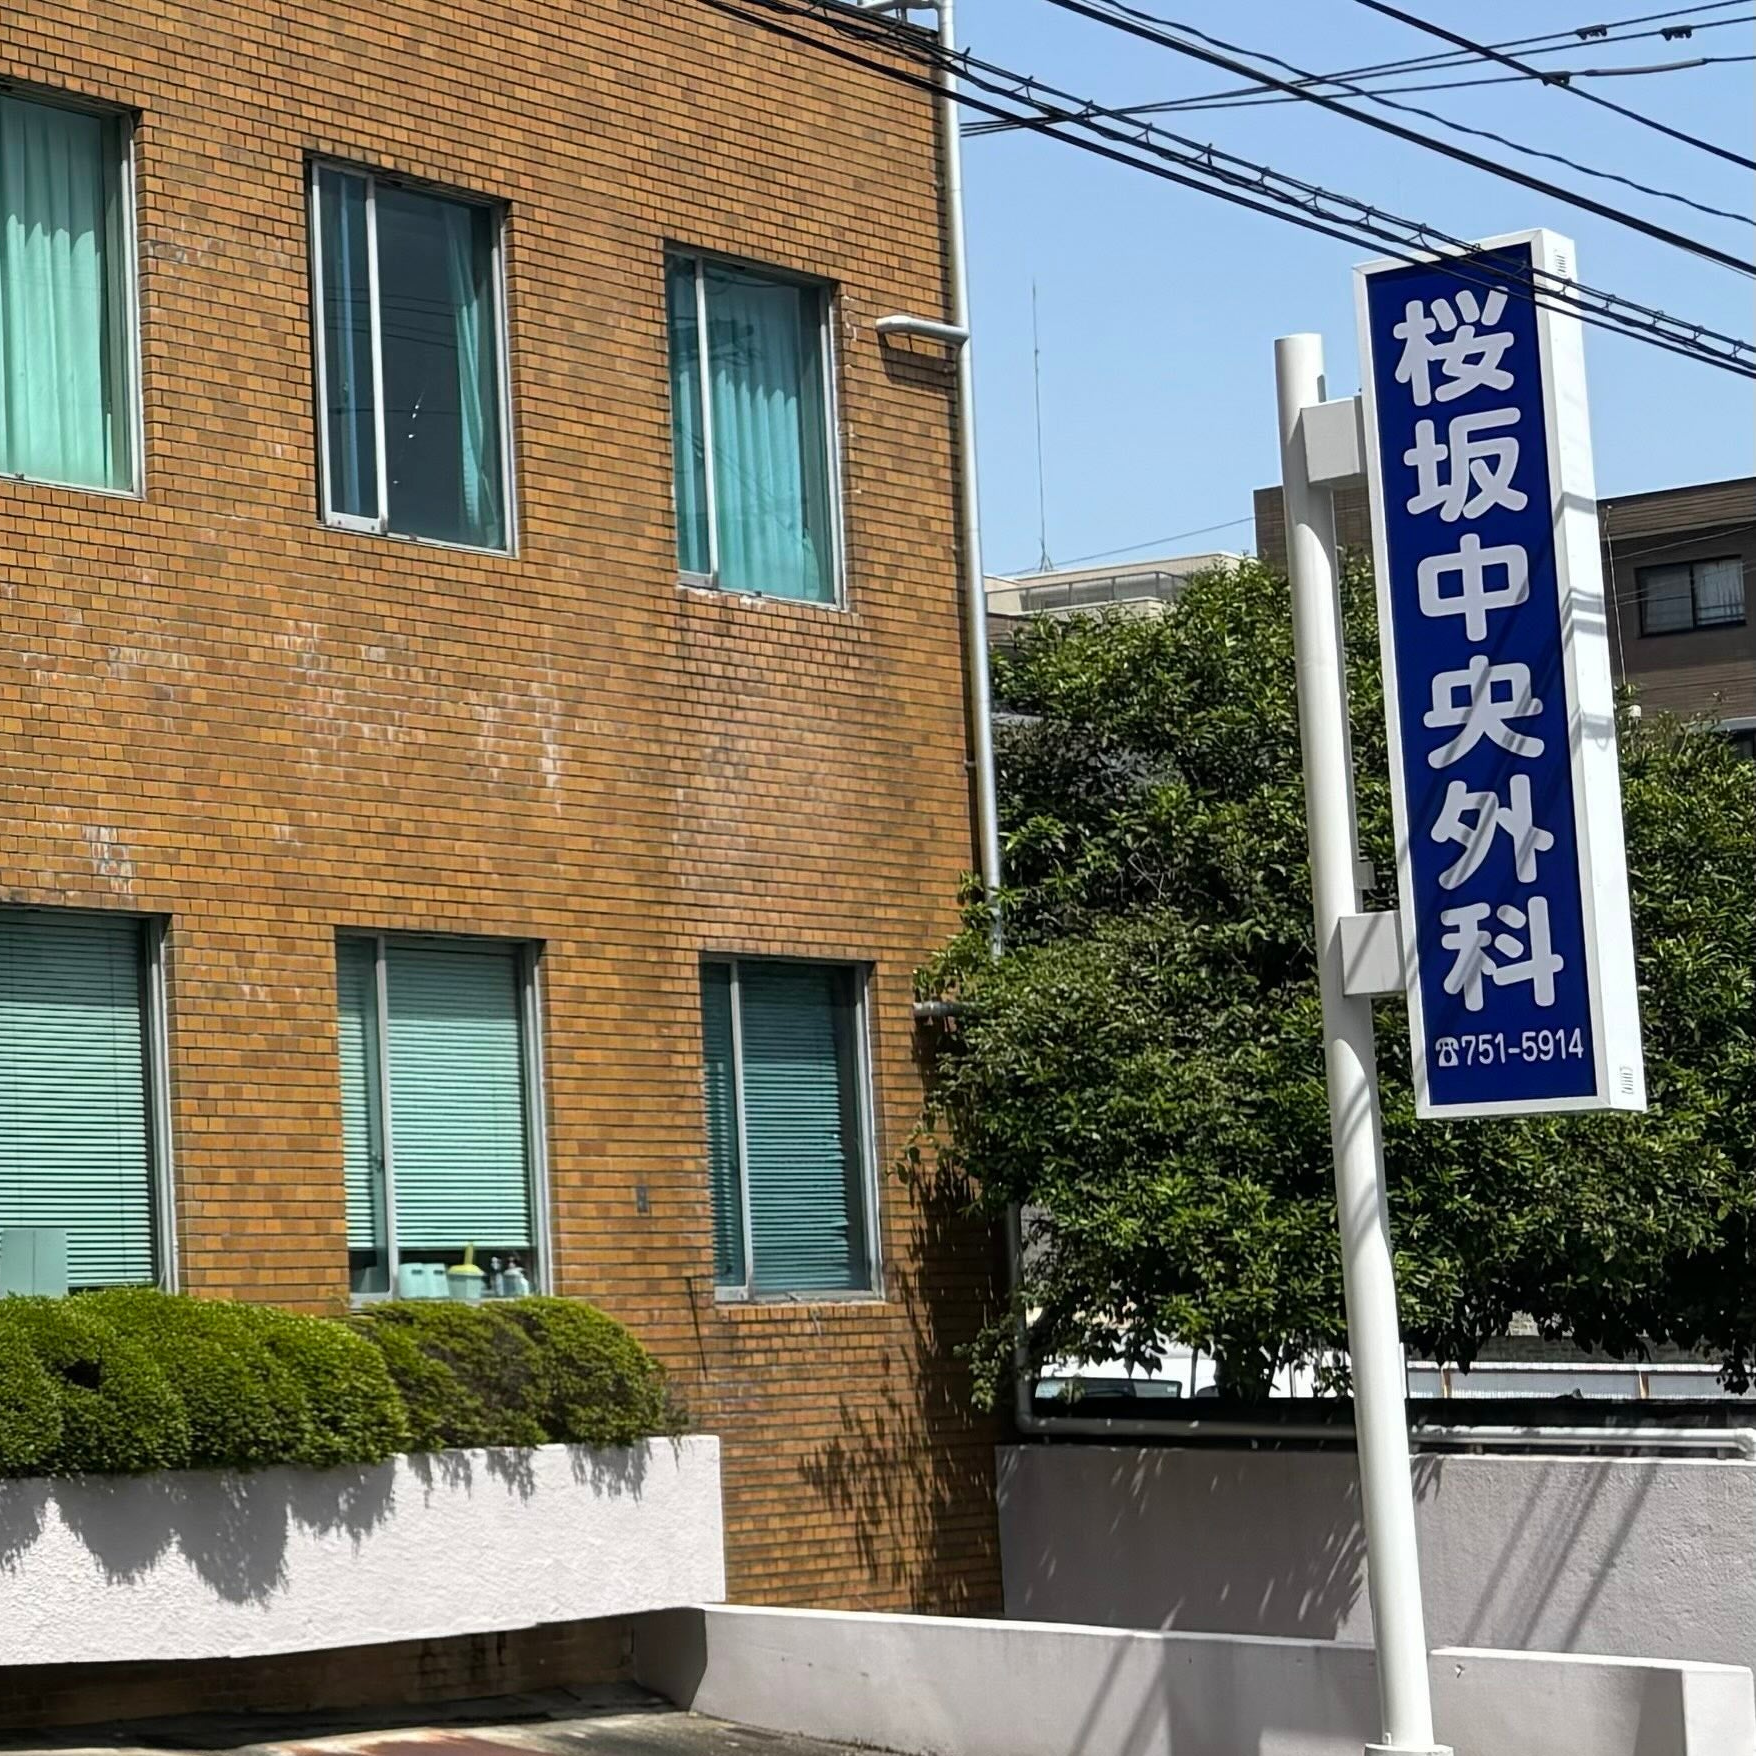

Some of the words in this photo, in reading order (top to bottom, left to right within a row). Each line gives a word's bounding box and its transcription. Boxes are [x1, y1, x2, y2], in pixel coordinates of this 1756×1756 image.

[1392, 286, 1566, 1013] 桜坂中央外科
